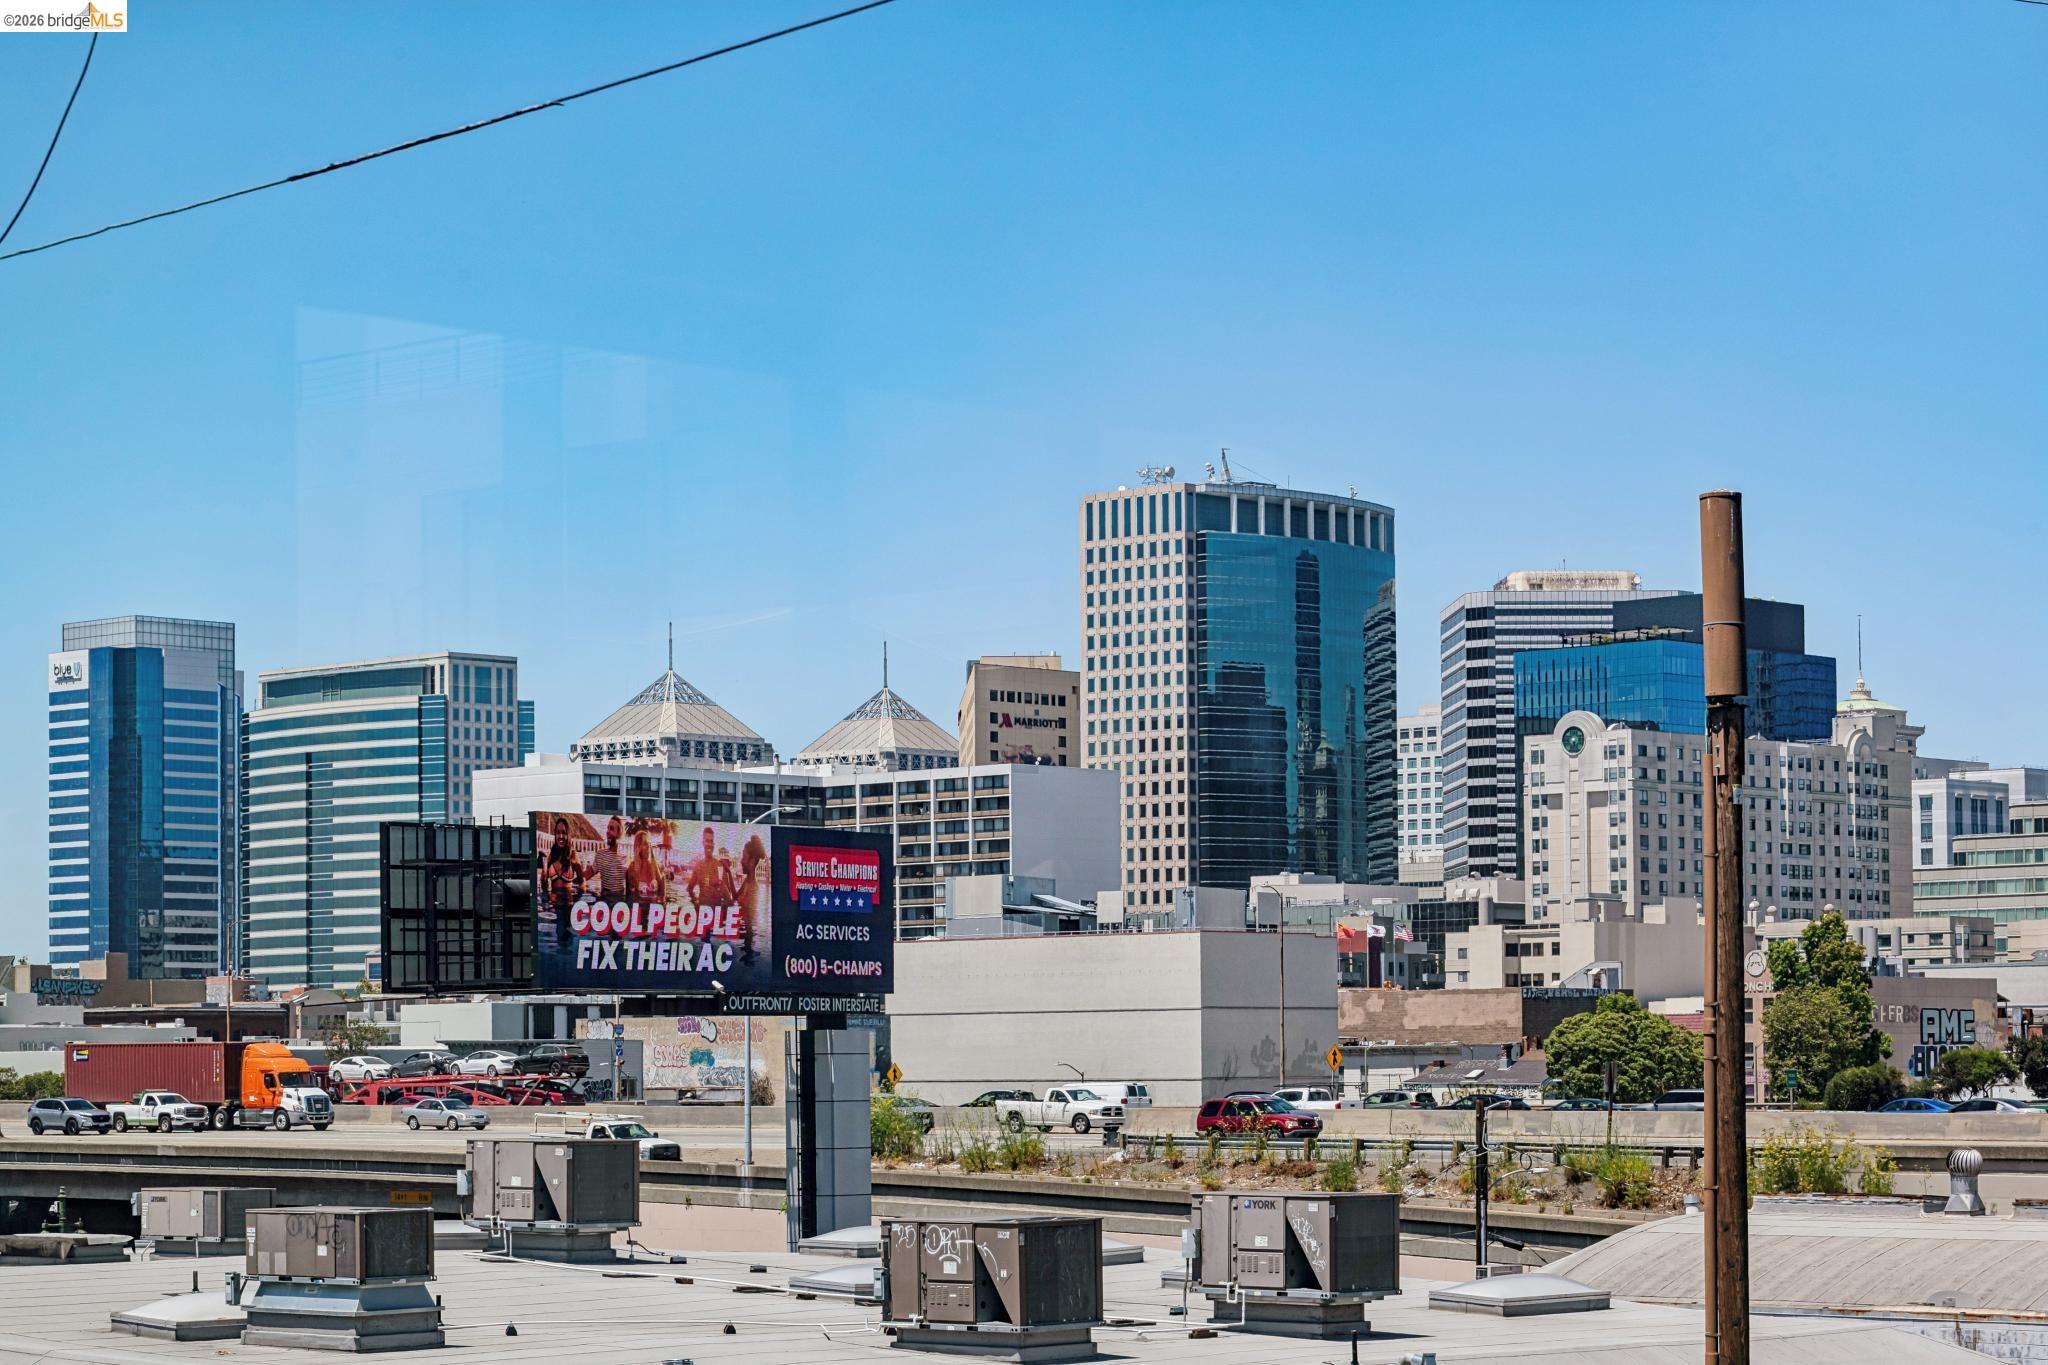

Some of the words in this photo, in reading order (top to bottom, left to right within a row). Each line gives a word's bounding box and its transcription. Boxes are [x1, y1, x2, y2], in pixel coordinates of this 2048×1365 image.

[53, 663, 72, 677] blue
[1014, 716, 1059, 729] MARRIOTT
[570, 900, 643, 936] COOL
[647, 902, 741, 939] PEOPLE
[796, 924, 814, 940] AC
[816, 924, 870, 941] SERVICES
[576, 940, 620, 970] FIX
[623, 941, 694, 971] THEIR
[696, 943, 733, 972] AC
[785, 954, 818, 978] (800)
[820, 959, 883, 976] 5-CHAMPS
[798, 997, 831, 1012] FOSTER
[832, 998, 879, 1012] INTERSTATE
[1252, 1200, 1276, 1210] YORK
